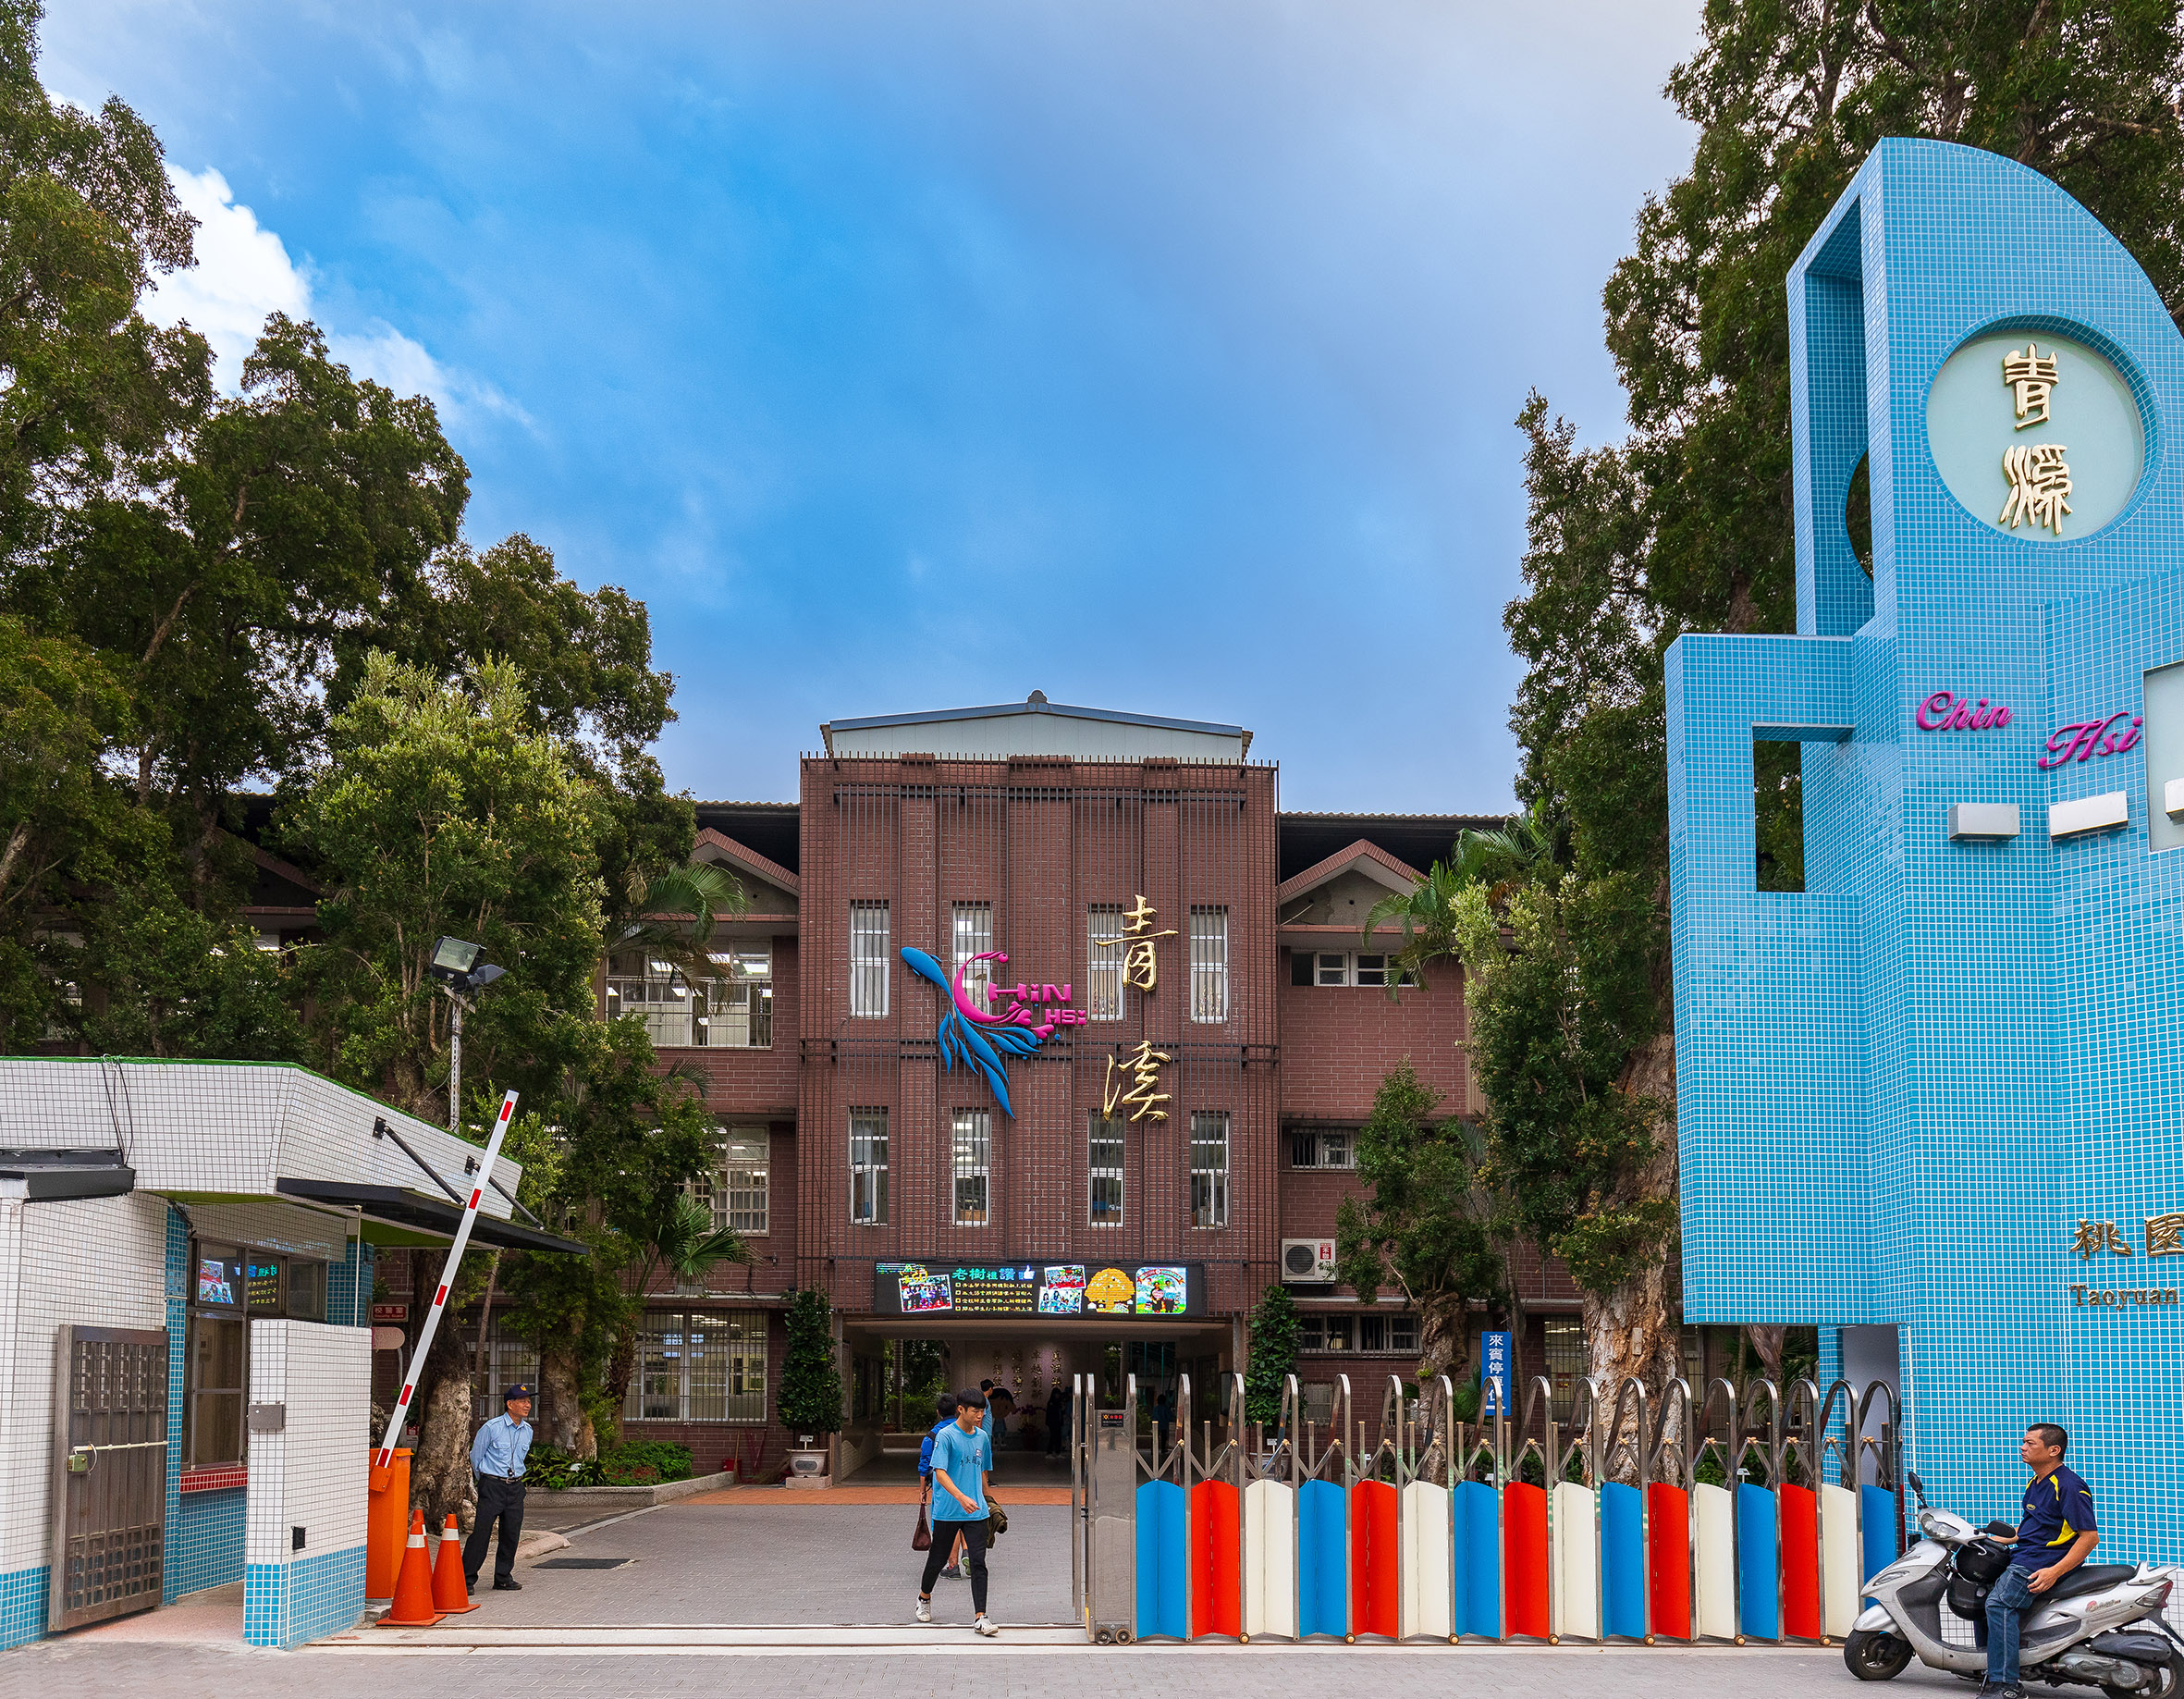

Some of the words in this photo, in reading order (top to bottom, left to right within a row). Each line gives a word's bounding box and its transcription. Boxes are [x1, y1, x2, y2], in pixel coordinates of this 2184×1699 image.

[1916, 690, 2013, 731] Chin
[2039, 711, 2142, 769] Hsi
[2069, 1213, 2184, 1260] 桃園
[951, 1268, 1016, 1281] 老樹祖讚
[2068, 1284, 2179, 1311] Taoyuan
